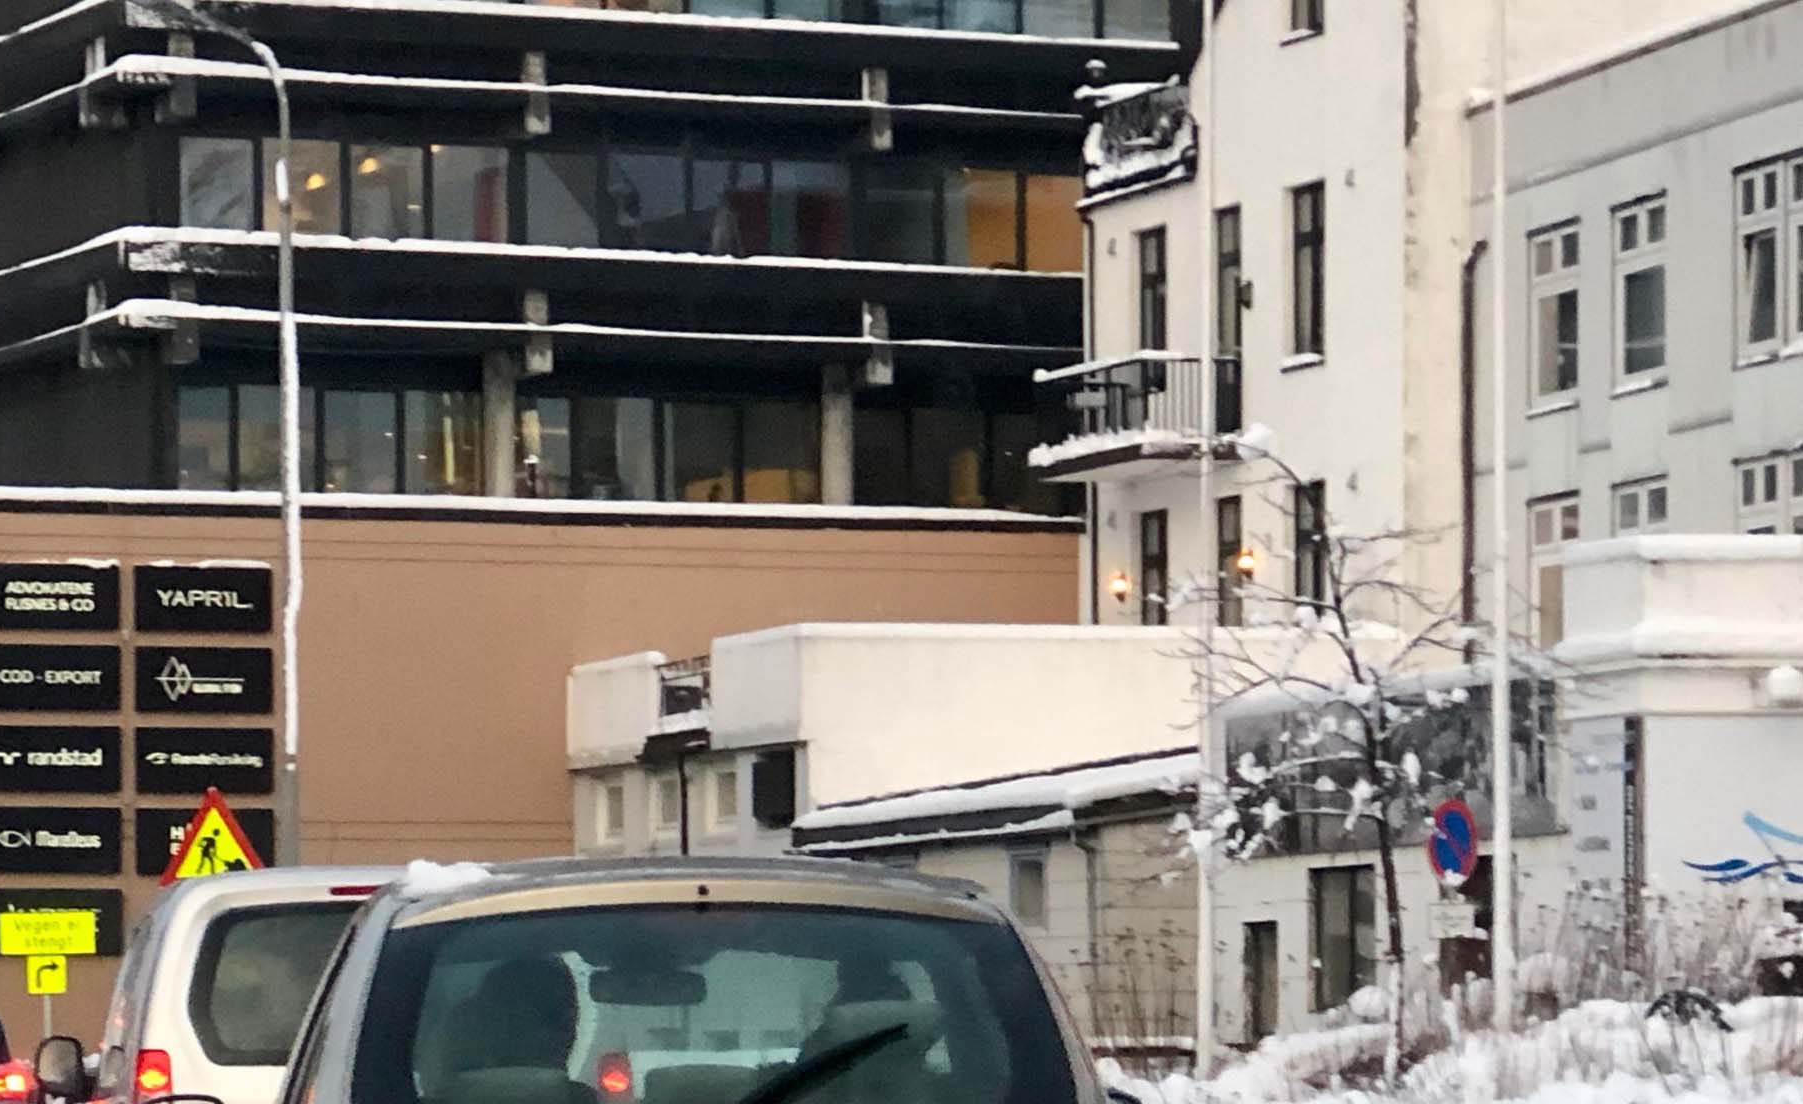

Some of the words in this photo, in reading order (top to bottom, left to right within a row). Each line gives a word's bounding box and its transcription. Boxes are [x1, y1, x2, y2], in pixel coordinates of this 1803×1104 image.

[70, 598, 95, 611] CO
[44, 670, 103, 684] EXPORT
[27, 747, 103, 766] randstad
